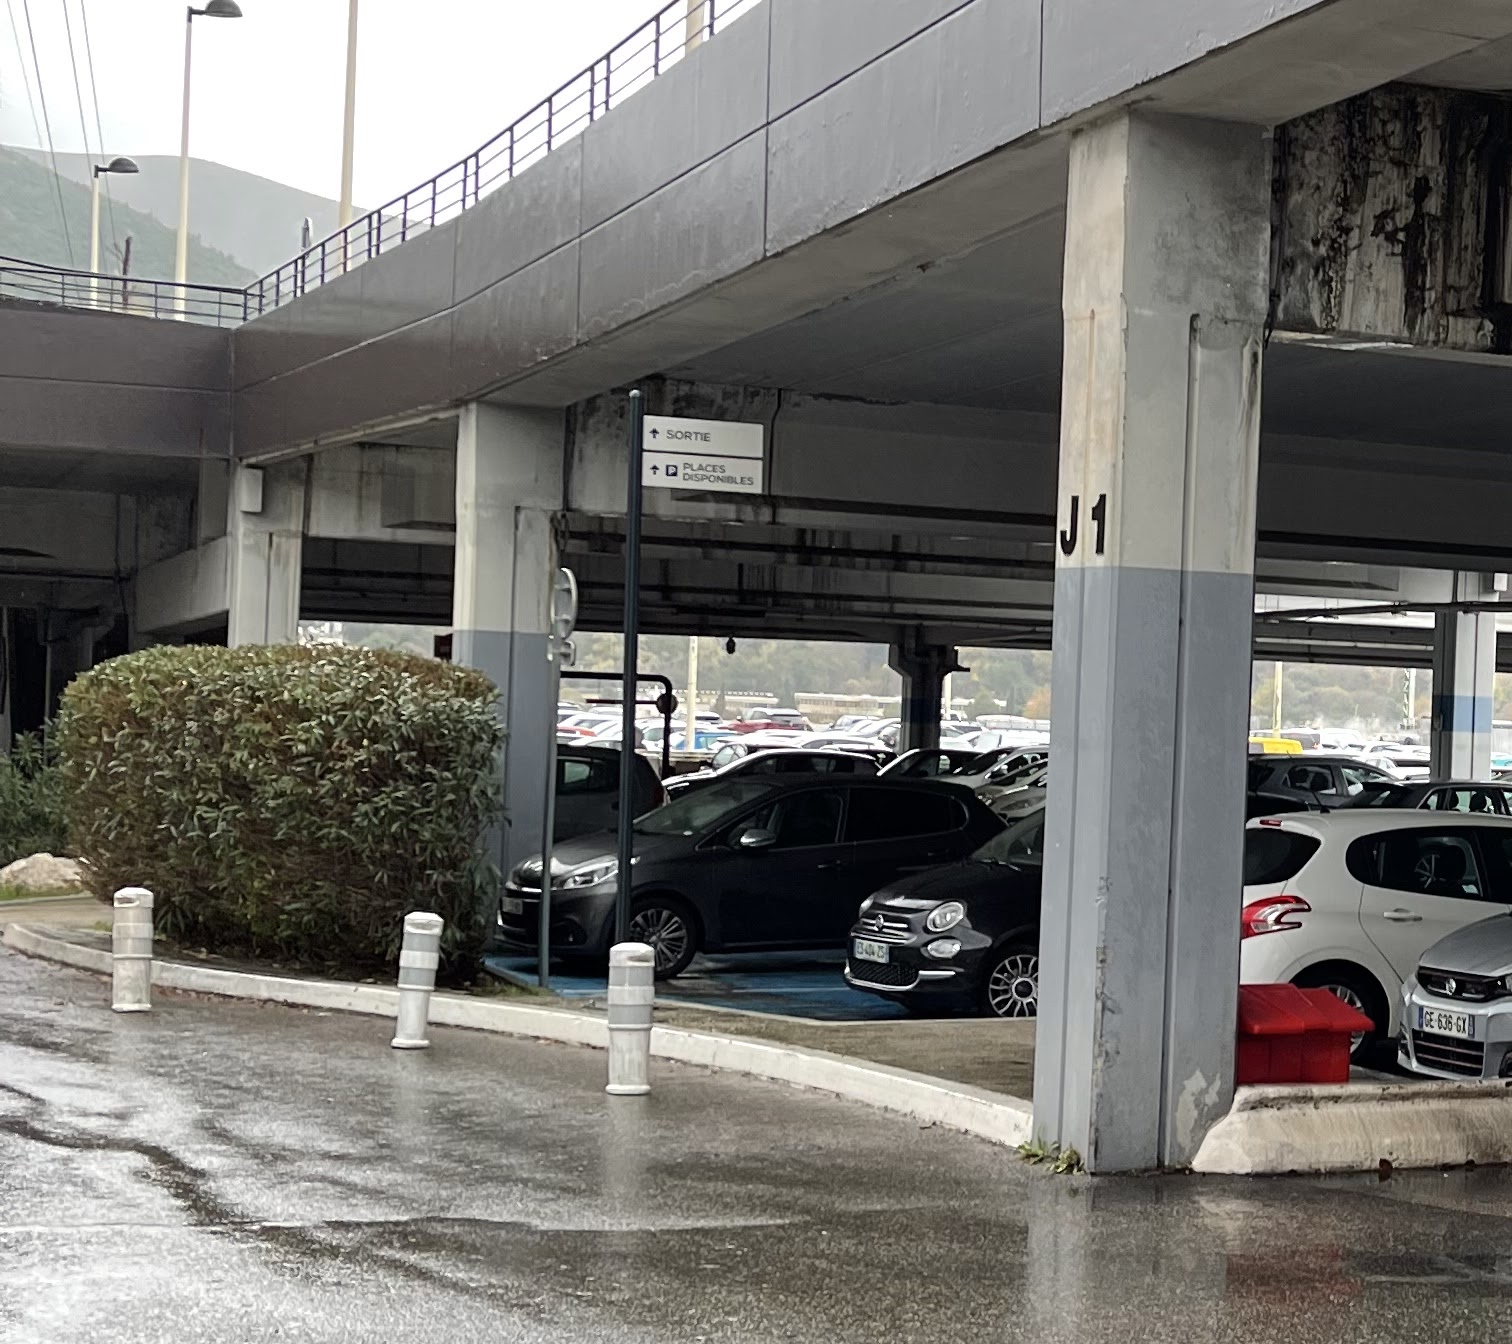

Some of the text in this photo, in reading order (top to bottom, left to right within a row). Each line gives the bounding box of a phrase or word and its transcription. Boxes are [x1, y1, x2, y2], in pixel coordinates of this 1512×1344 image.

[666, 429, 711, 442] SORTIE
[683, 463, 726, 473] PLACES
[683, 473, 754, 485] DISPONIBLES
[1424, 1010, 1467, 1034] GE-636-GX
